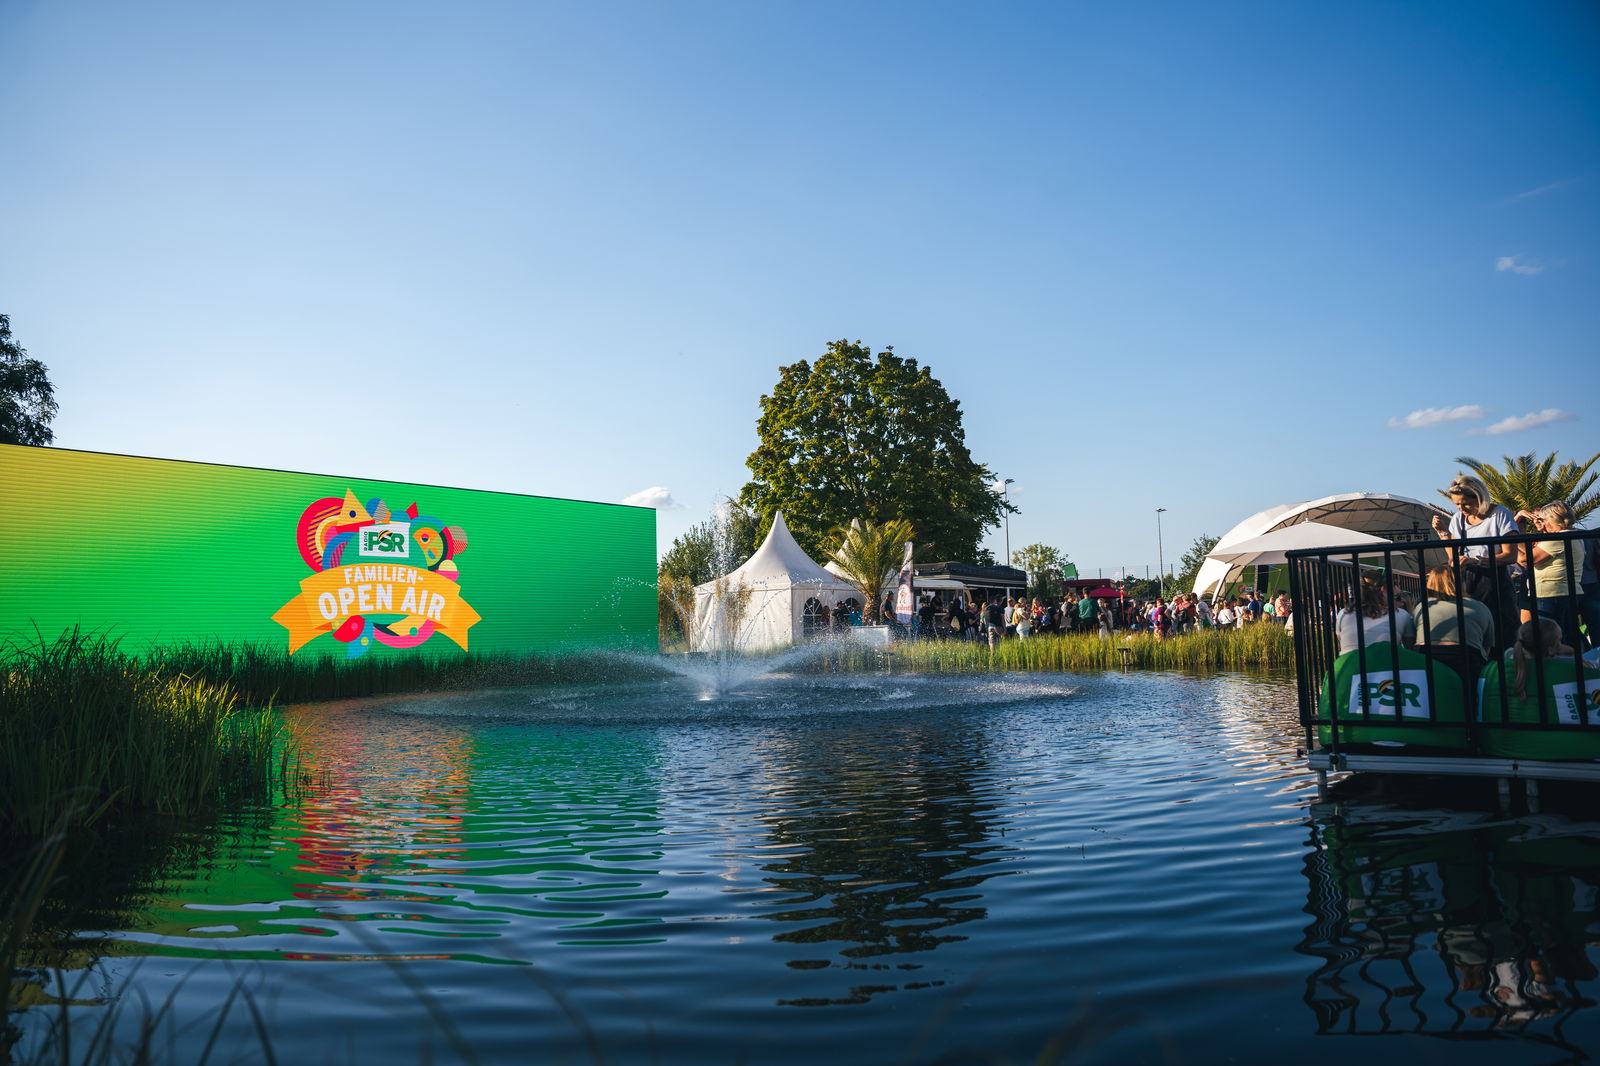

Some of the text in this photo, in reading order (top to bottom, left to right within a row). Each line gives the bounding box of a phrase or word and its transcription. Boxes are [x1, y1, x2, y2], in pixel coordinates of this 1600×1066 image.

[368, 530, 405, 552] PSR
[343, 565, 424, 584] FAMILIEN-
[318, 583, 446, 621] OPEN AIR
[1366, 680, 1421, 707] PSR
[1564, 694, 1579, 720] RADIO
